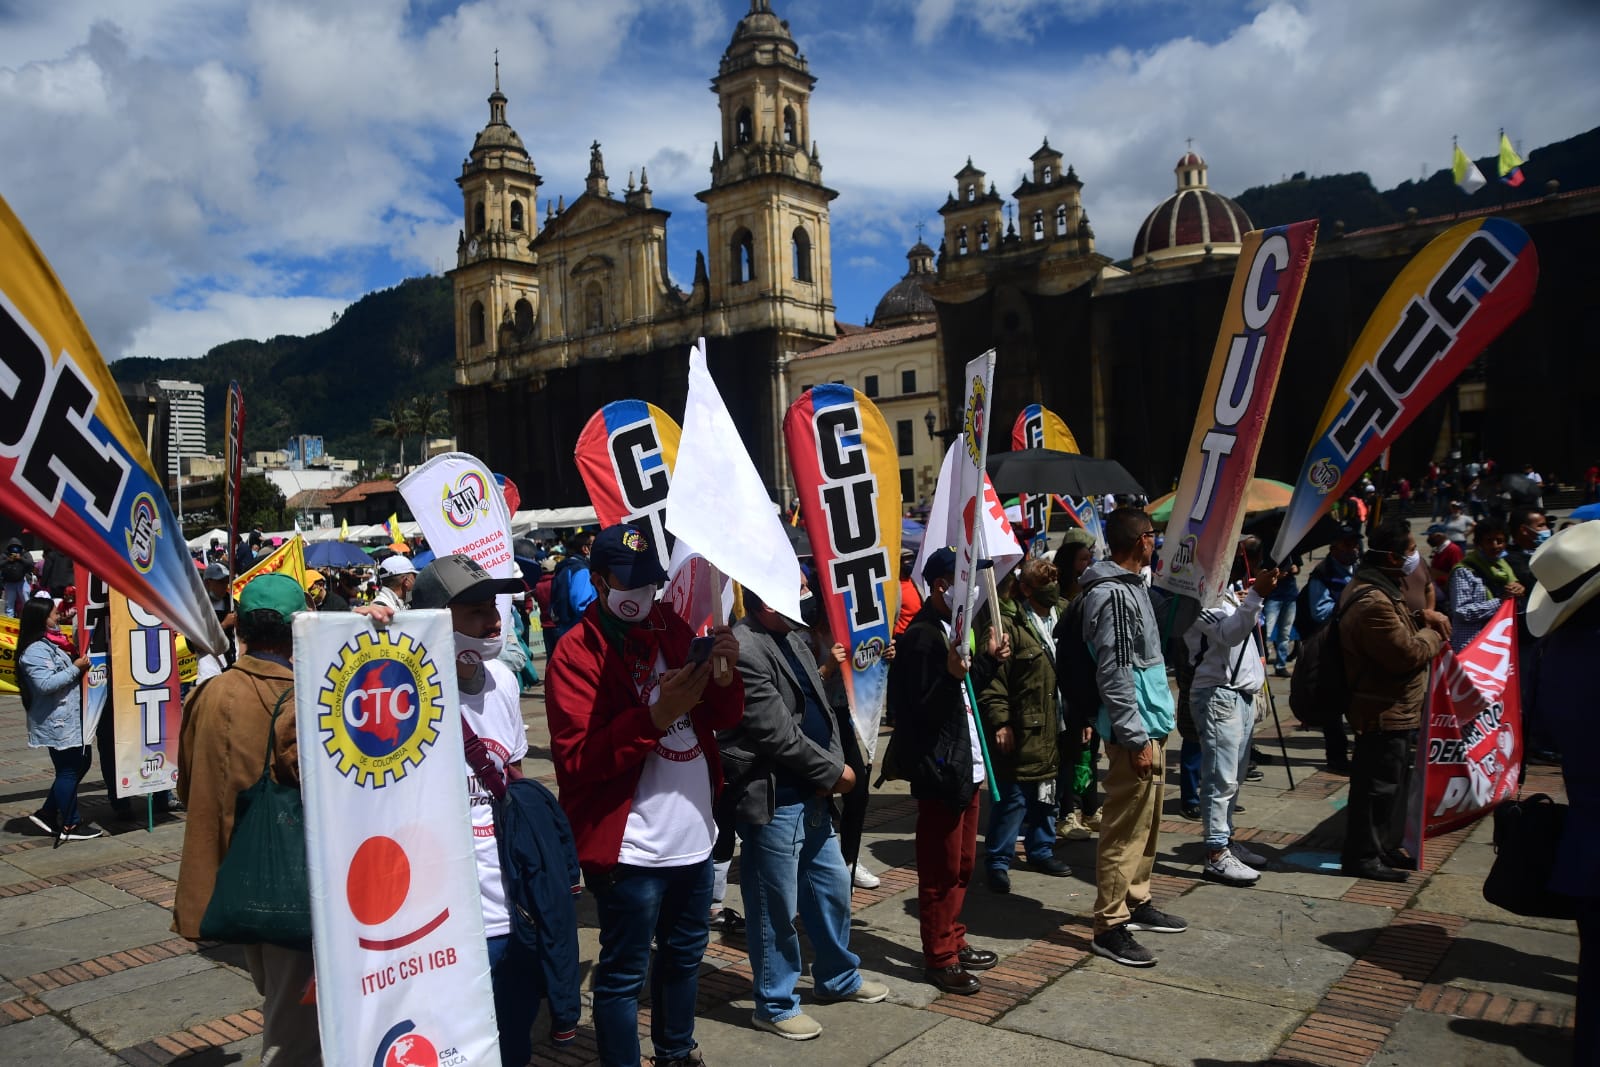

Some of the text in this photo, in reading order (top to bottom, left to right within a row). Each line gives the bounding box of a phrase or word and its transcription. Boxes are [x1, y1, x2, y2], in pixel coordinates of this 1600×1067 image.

[814, 405, 889, 628] CUT
[452, 530, 504, 556] DEMOCRACIA
[471, 542, 505, 561] RANTIAS
[480, 552, 511, 570] ICALES
[379, 648, 391, 659] DE
[396, 651, 428, 704] TRABAJADORES
[343, 682, 416, 728] CTC
[359, 747, 408, 768] DE COLOMBIA
[361, 947, 457, 996] ITUC CSI IGB
[439, 1047, 458, 1060] CSA
